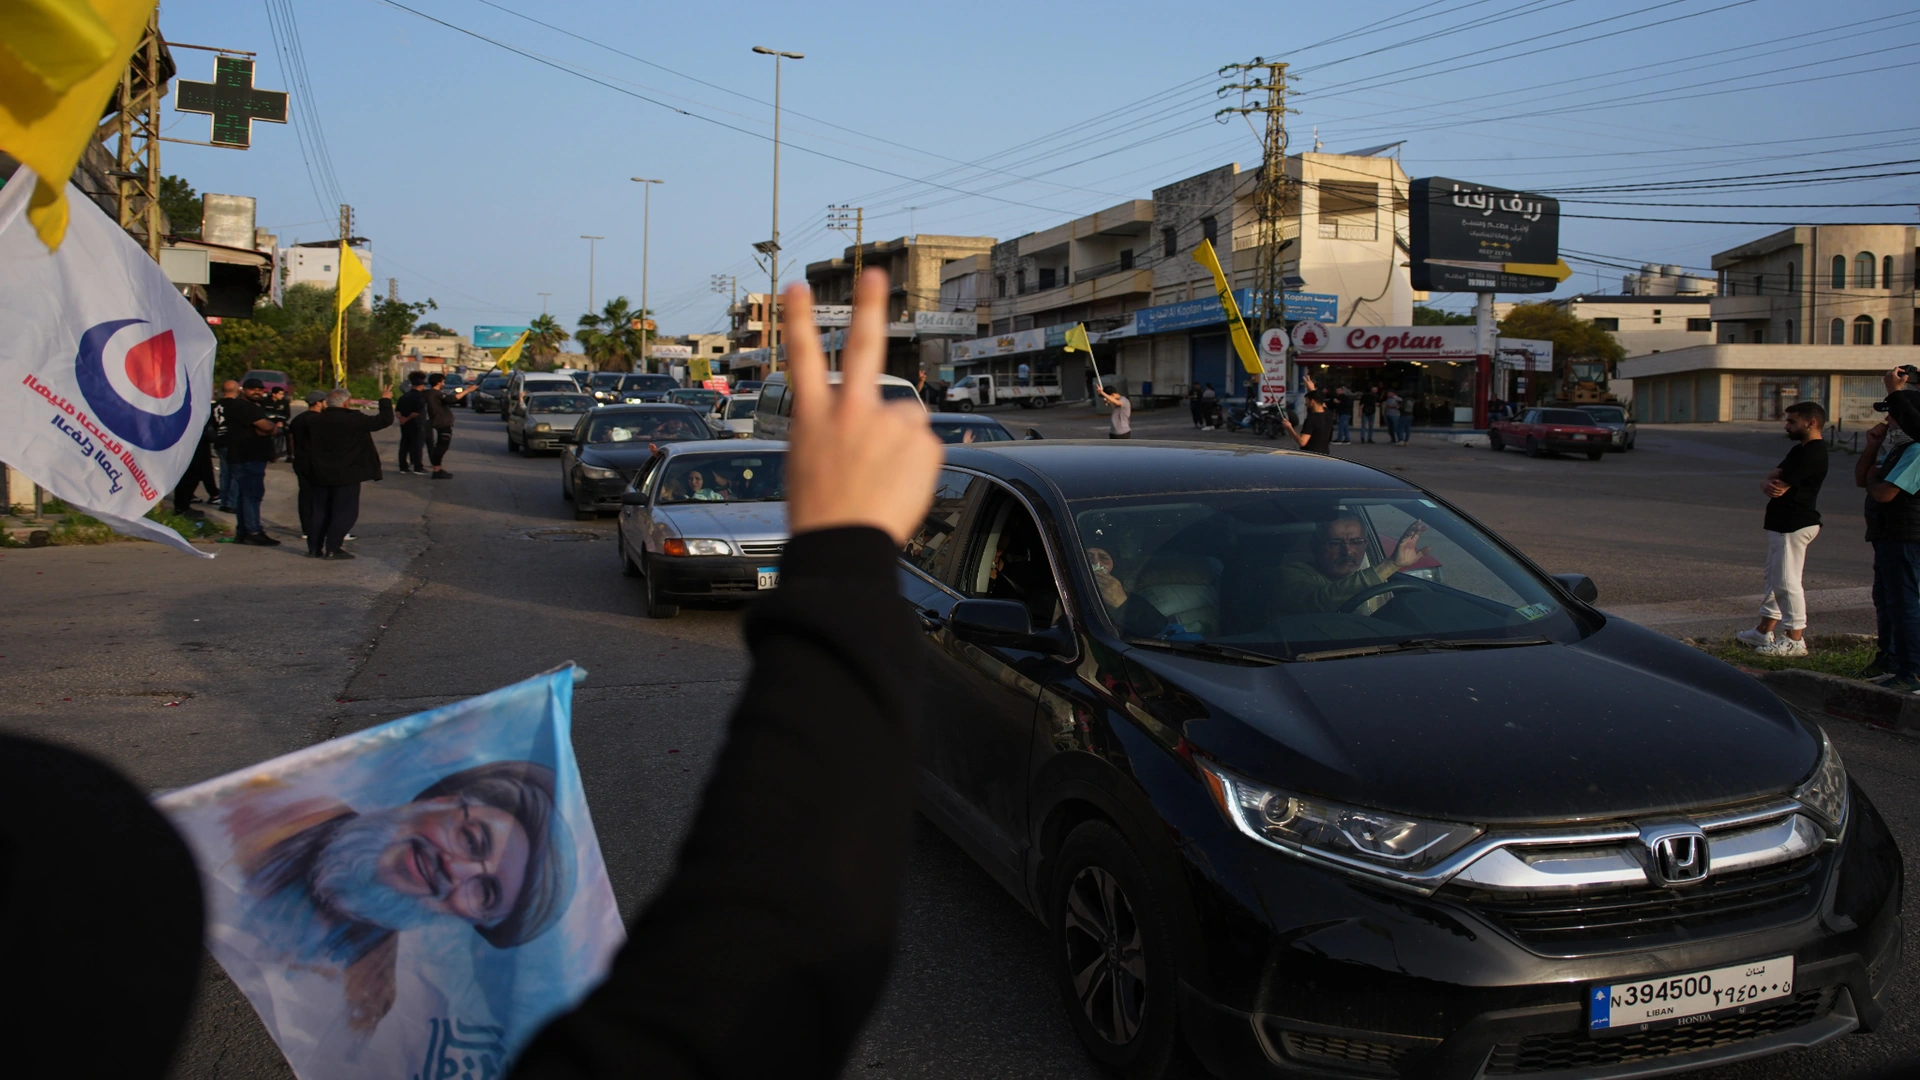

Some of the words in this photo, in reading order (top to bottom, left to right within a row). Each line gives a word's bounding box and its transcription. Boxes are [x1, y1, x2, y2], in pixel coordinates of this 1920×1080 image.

[1453, 183, 1495, 216] زفتا
[1499, 194, 1542, 222] ريف
[1284, 293, 1313, 302] Koptan
[1177, 302, 1202, 318] Koptan
[917, 312, 975, 326] Maha's
[1293, 321, 1308, 338] COPTAN
[1346, 328, 1444, 355] Coptan
[1745, 966, 1765, 977] لبنان
[1624, 975, 1711, 1006] 394500
[1646, 1007, 1674, 1017] LIBAN
[1678, 1013, 1712, 1026] HONDA
